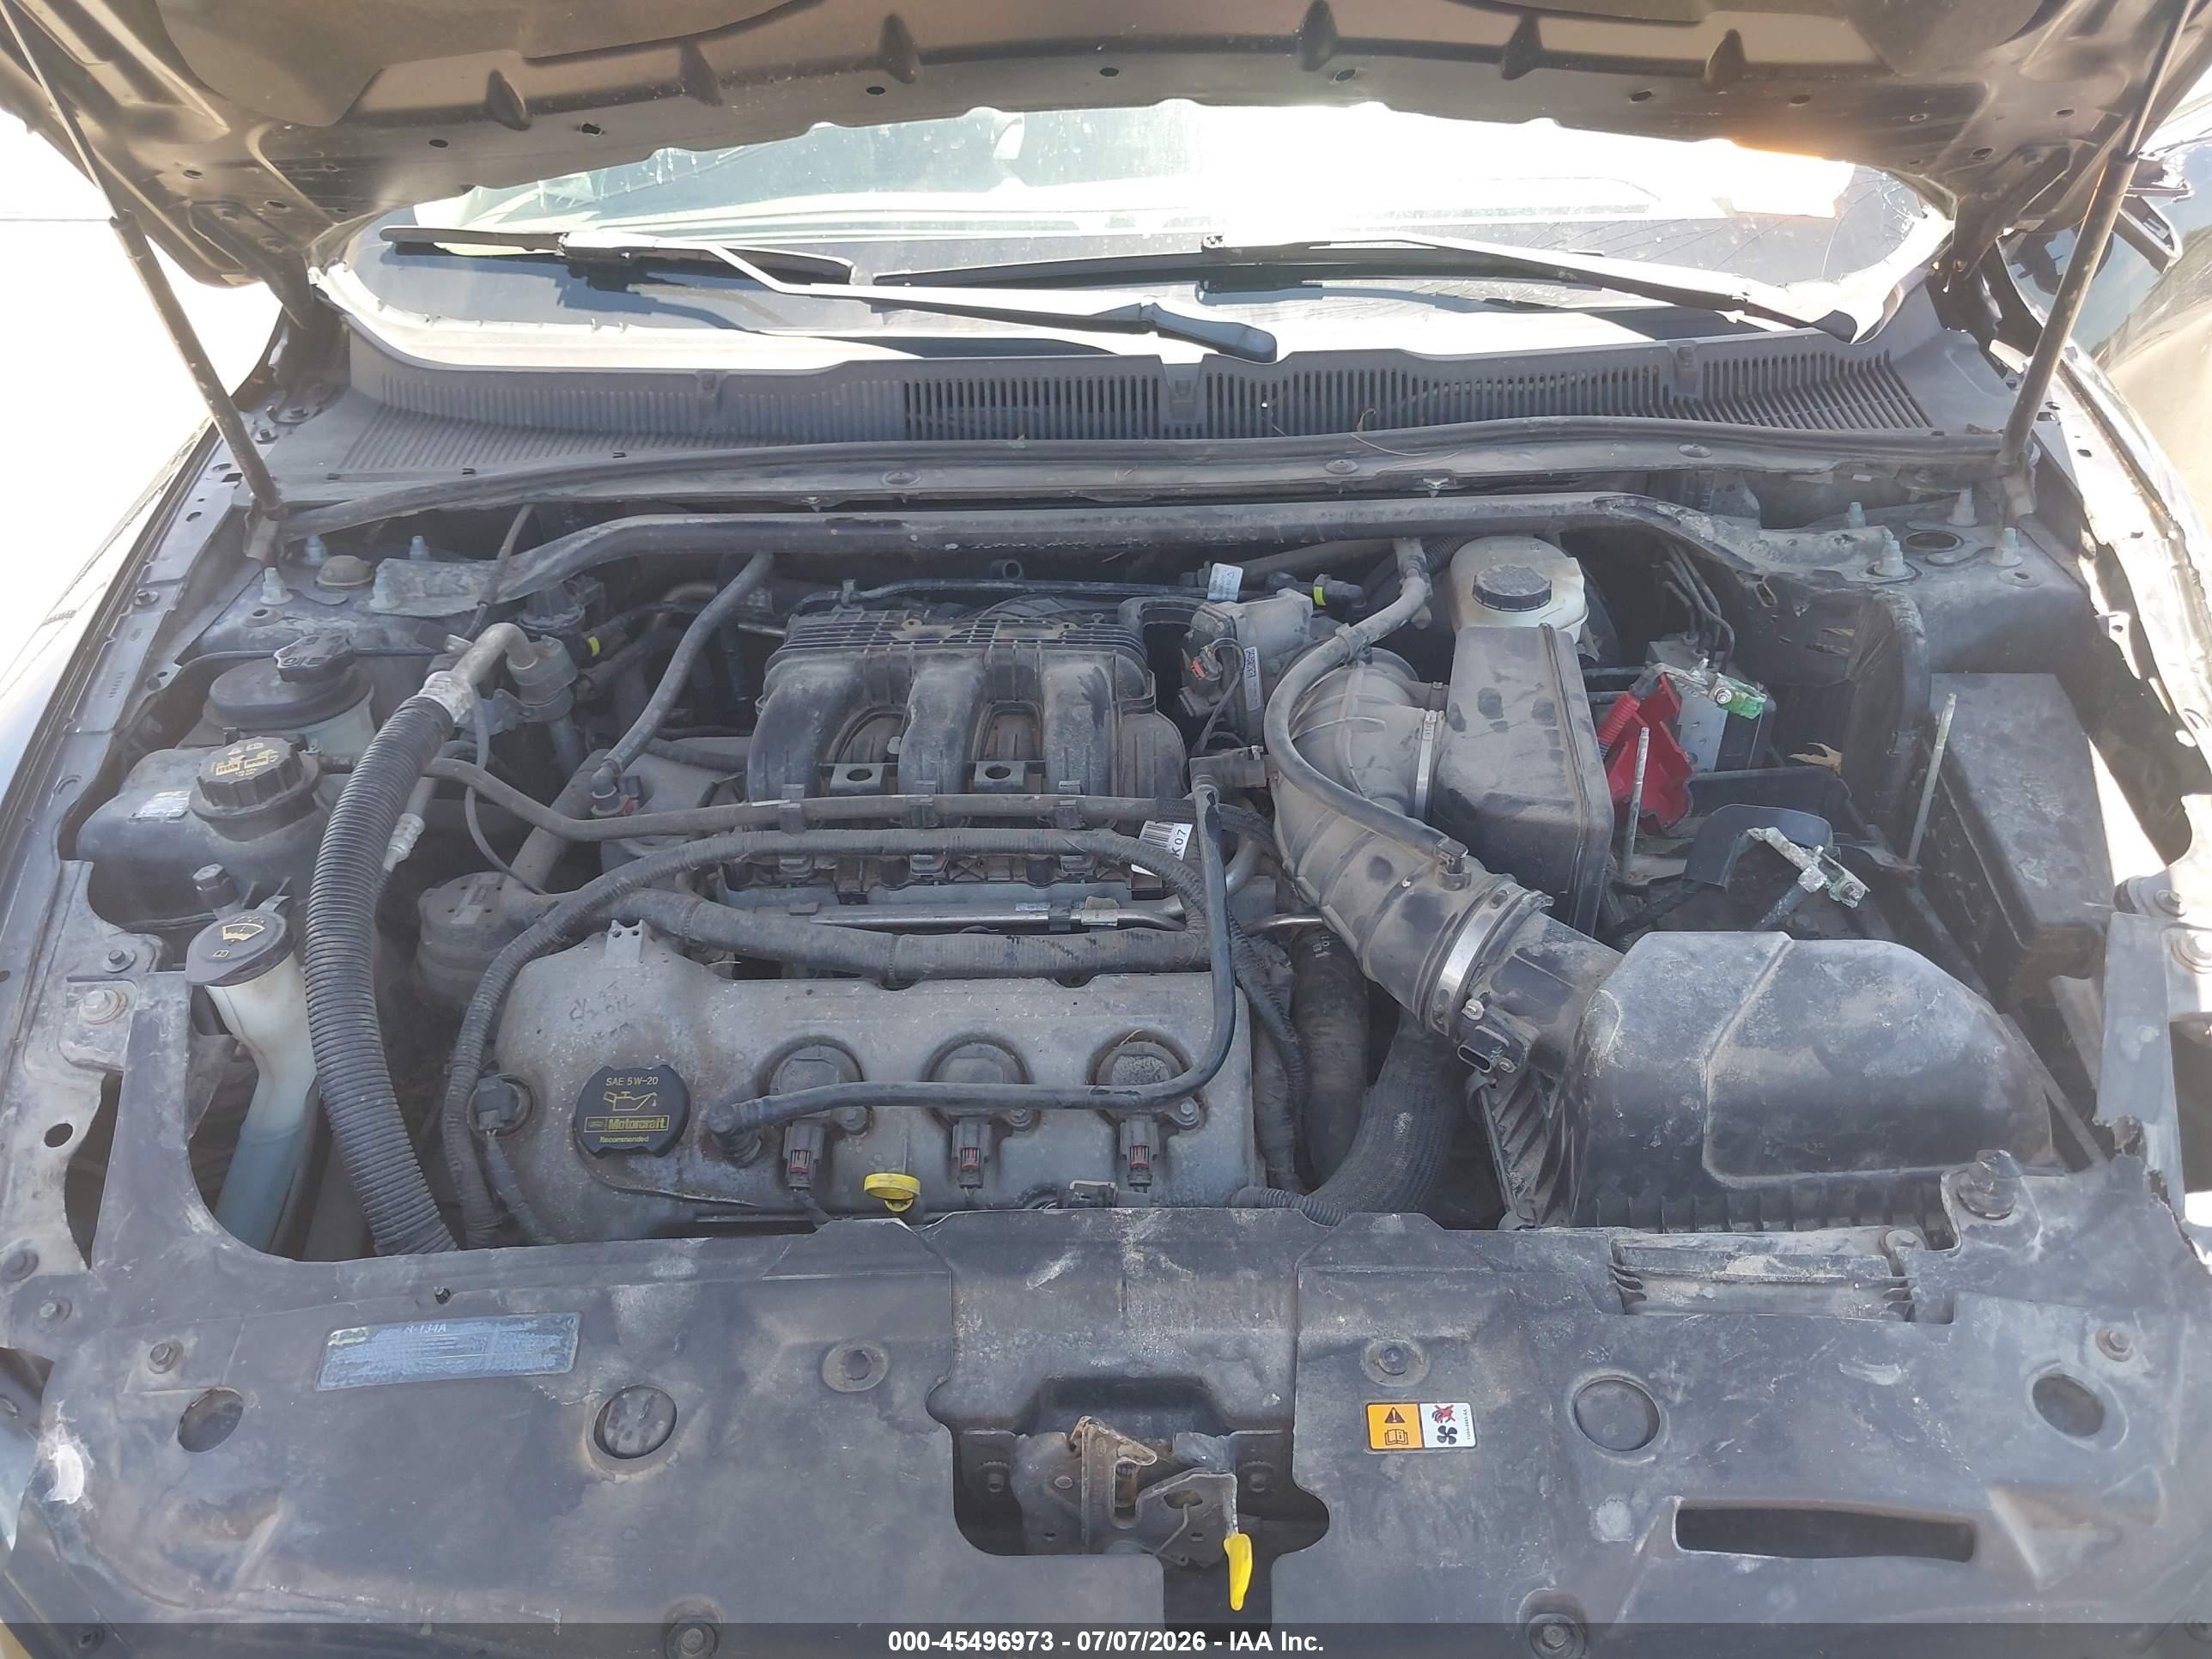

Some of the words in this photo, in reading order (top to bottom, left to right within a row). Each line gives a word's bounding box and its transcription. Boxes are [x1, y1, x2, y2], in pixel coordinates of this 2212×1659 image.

[1170, 829, 1187, 857] K07
[605, 1077, 624, 1086] SAE
[627, 1076, 659, 1085] 5W-20
[608, 1117, 666, 1130] Motorcraft
